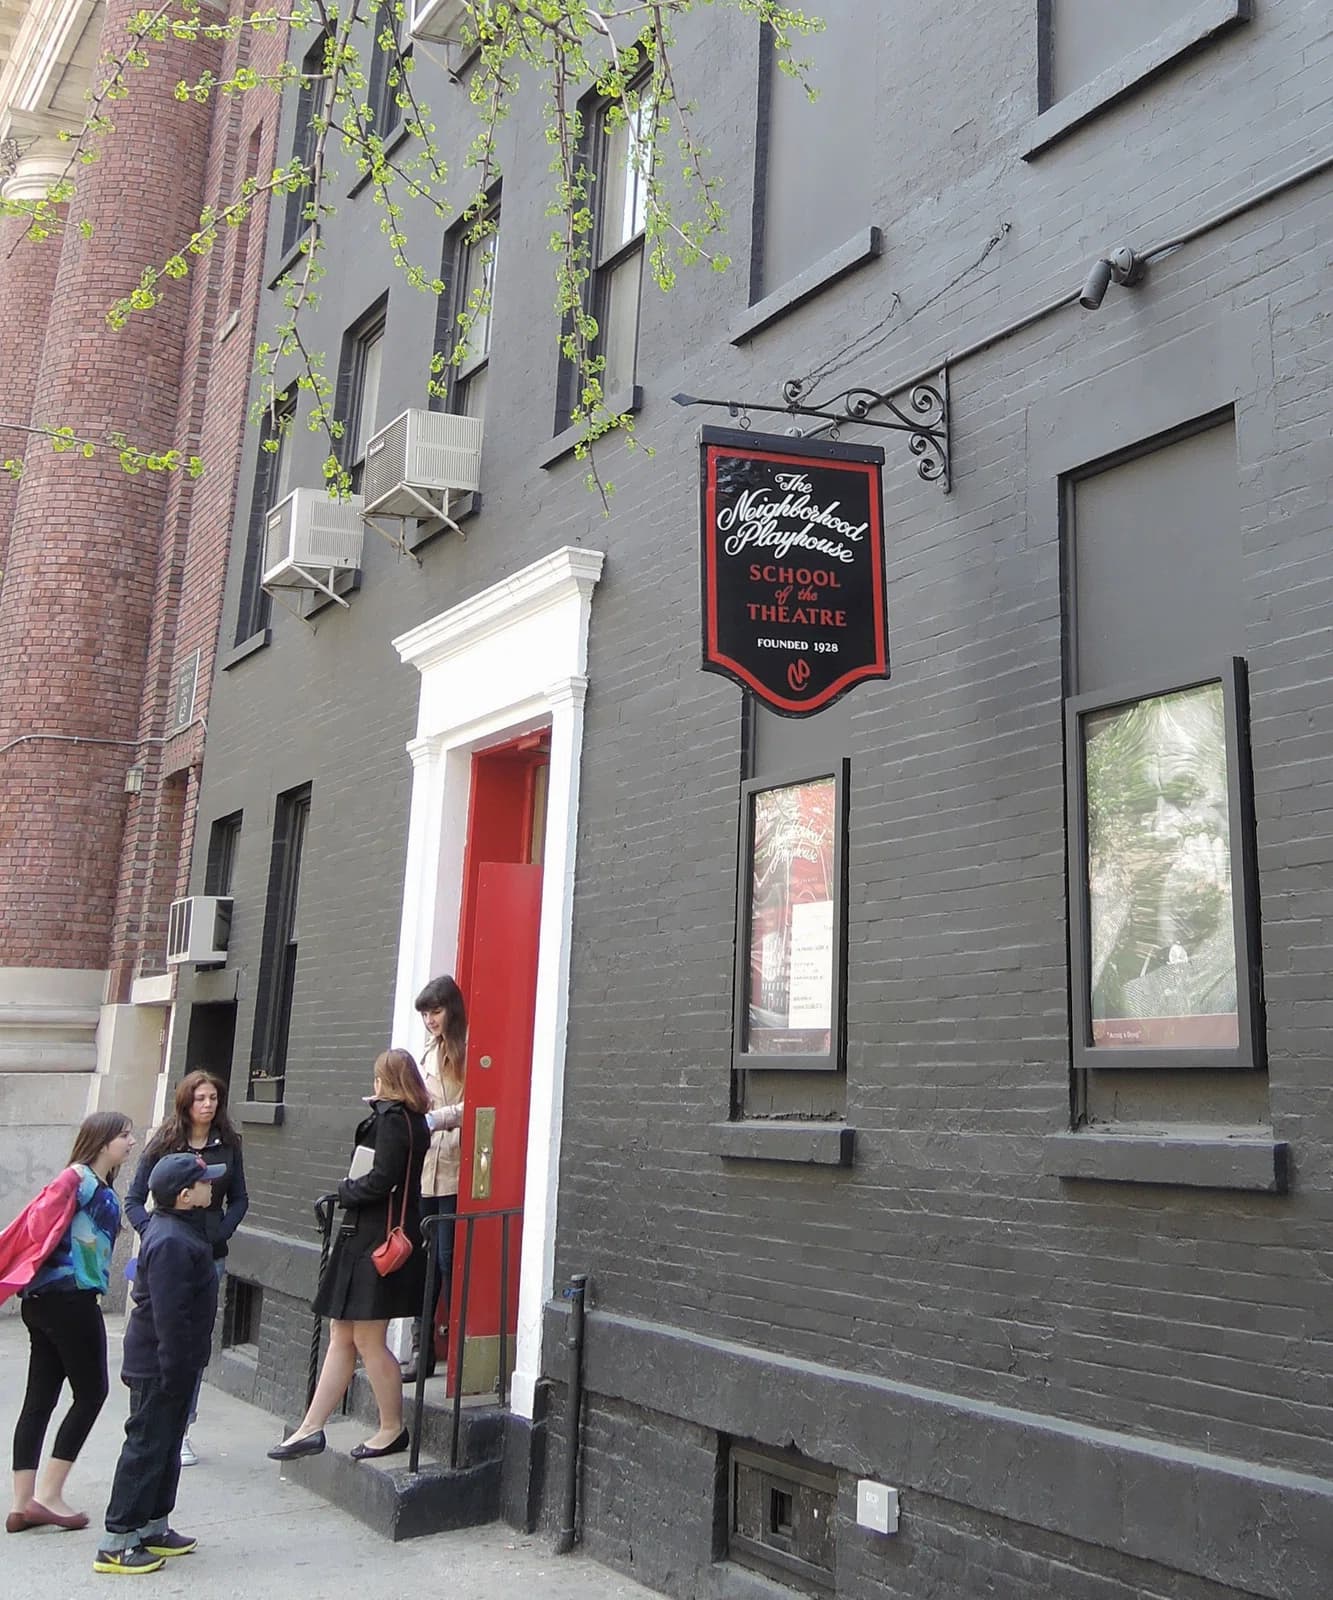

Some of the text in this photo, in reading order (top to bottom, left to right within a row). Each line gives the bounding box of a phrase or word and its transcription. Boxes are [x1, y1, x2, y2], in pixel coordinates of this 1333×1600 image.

[774, 473, 813, 493] The
[717, 488, 868, 541] Neighborhood
[725, 520, 855, 563] Playhouse
[749, 564, 841, 588] SCHOOL
[774, 585, 818, 605] of the
[746, 603, 847, 627] THEATRE
[757, 638, 839, 653] FOUNDED 1928
